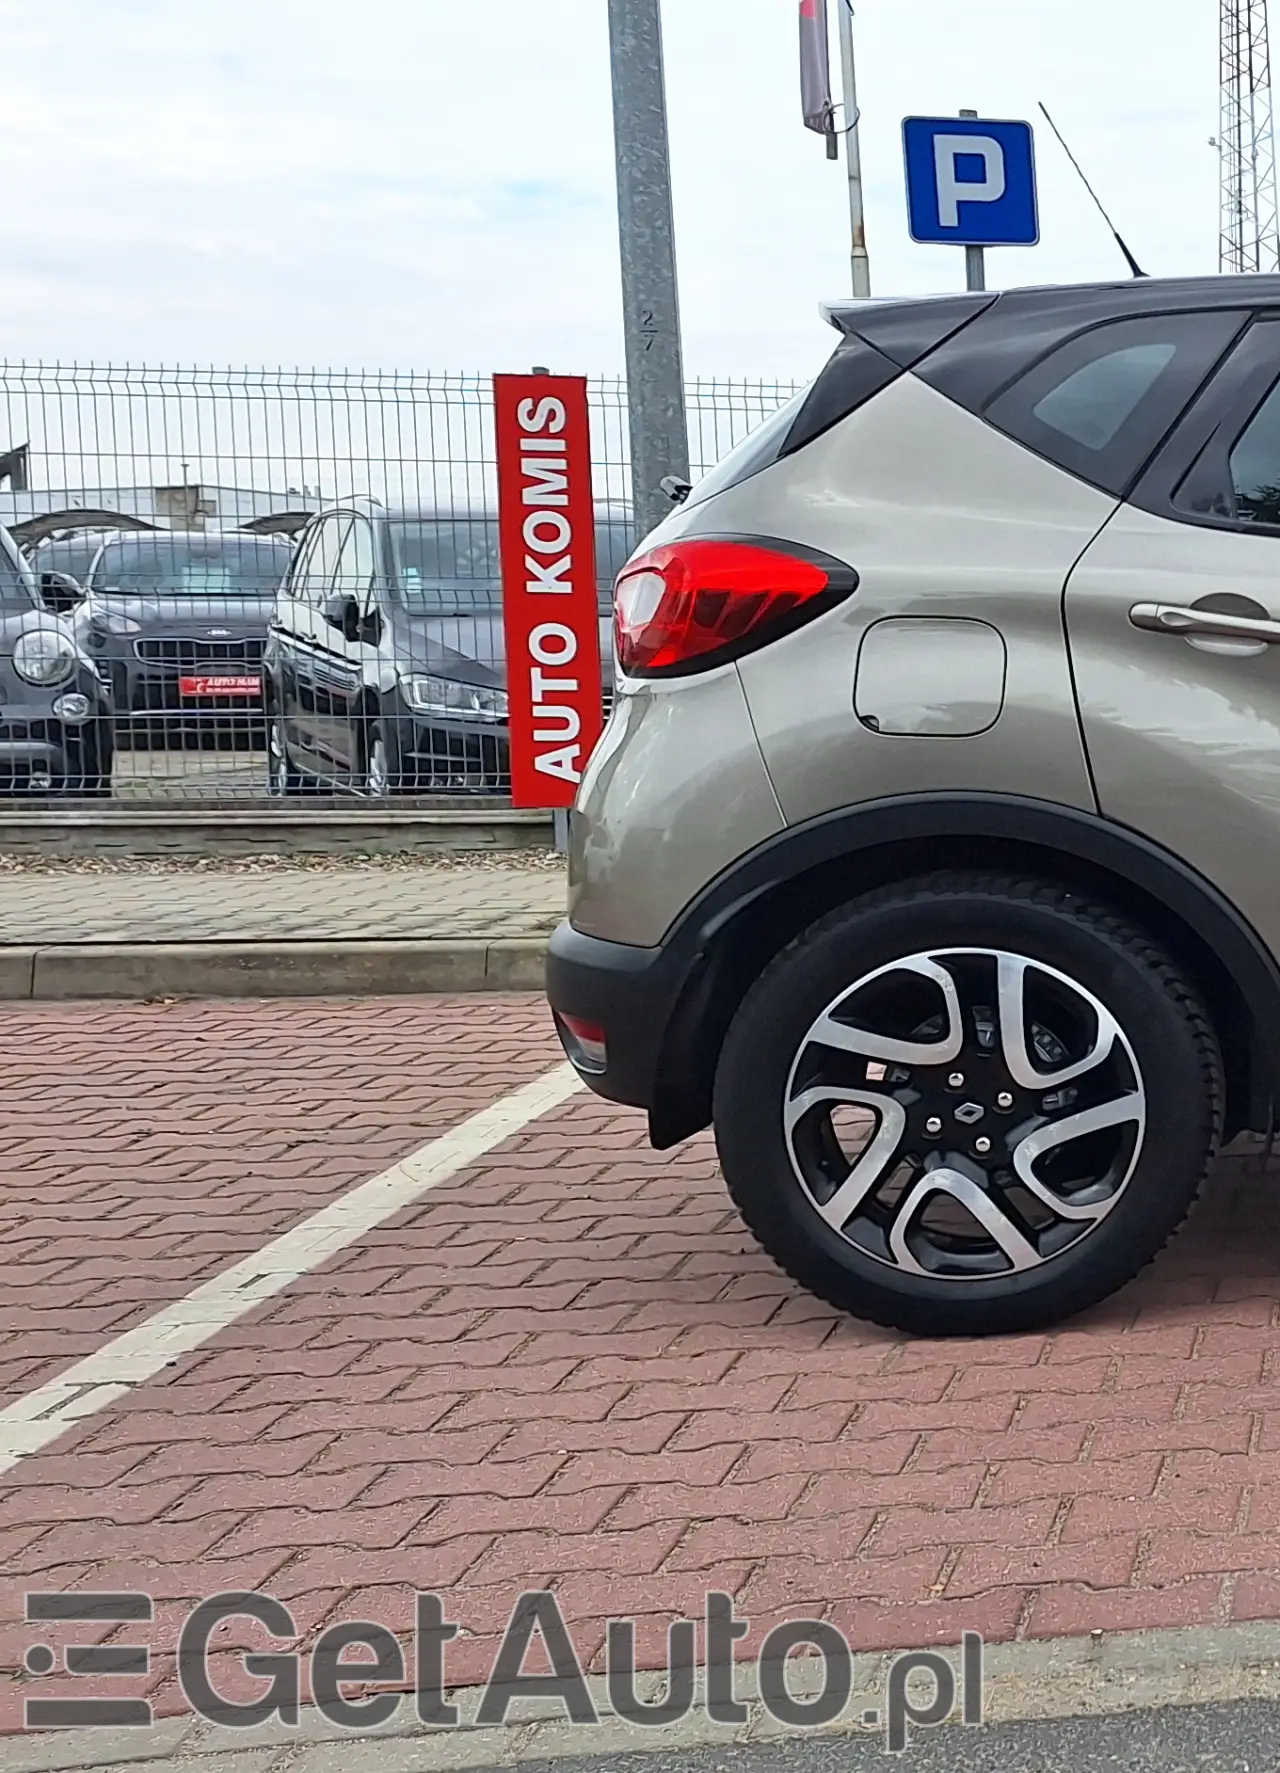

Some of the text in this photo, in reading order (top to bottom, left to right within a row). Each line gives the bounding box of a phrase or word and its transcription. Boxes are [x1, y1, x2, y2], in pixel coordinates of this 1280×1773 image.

[933, 134, 1006, 227] P
[517, 396, 582, 783] AUTO KOMIS
